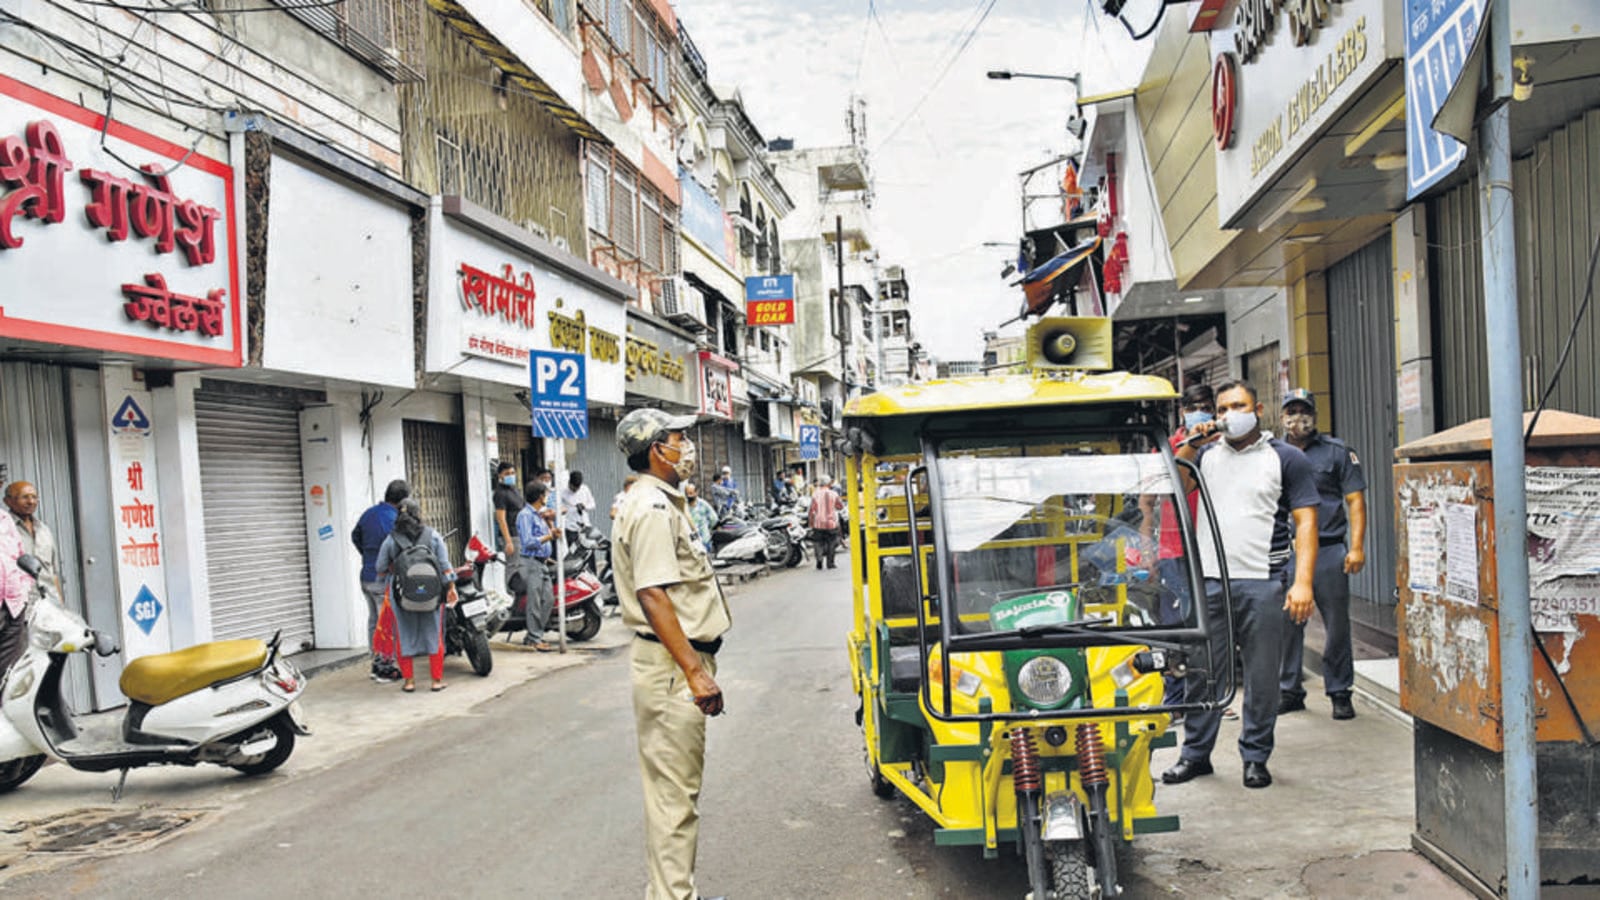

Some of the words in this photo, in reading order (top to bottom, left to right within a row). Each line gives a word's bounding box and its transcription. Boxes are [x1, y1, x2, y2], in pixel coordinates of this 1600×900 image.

[1286, 15, 1368, 141] JEWELLERS
[0, 119, 73, 249] श्री
[79, 162, 222, 267] गणेश
[121, 273, 226, 337] ज्वेलर्स
[755, 302, 787, 313] GOLD
[755, 312, 788, 323] LOAN
[535, 356, 581, 396] P2
[802, 427, 817, 442] P2
[127, 461, 143, 491] श्री
[121, 497, 155, 529] गणेश
